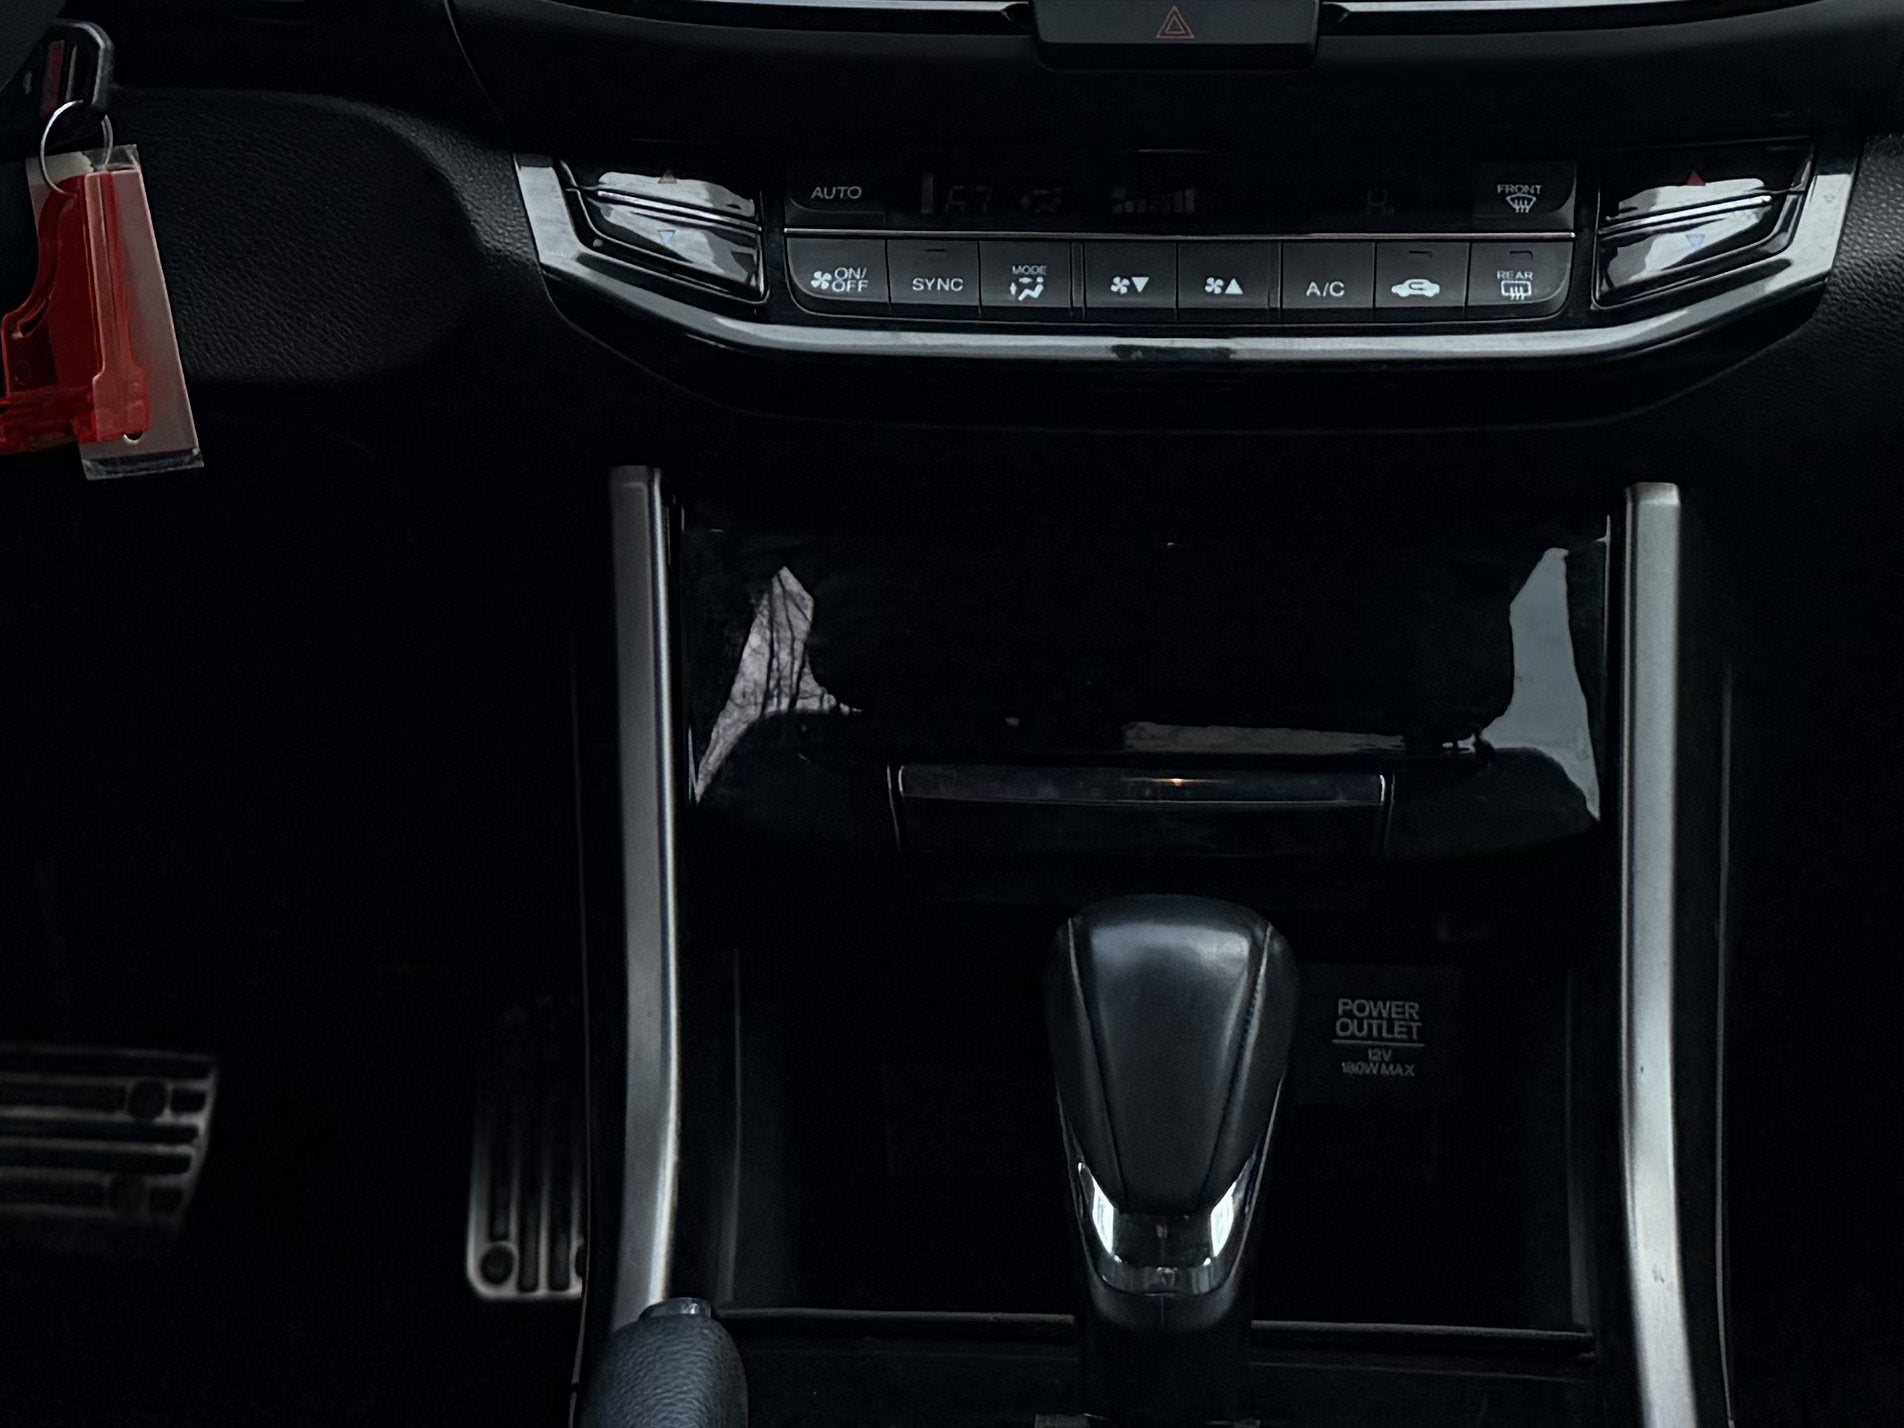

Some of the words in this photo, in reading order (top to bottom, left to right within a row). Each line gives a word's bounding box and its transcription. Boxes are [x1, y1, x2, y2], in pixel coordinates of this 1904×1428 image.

[810, 185, 863, 200] AUTO
[1496, 183, 1542, 194] FRONT
[834, 266, 867, 280] ON/
[1012, 264, 1048, 275] MODE
[1496, 270, 1533, 281] REAR
[831, 278, 869, 293] OFF
[912, 277, 964, 292] SYNC
[1305, 280, 1346, 297] A/C
[1338, 998, 1420, 1020] POWER
[1336, 1017, 1422, 1040] OUTLET
[1367, 1047, 1393, 1062] 12V
